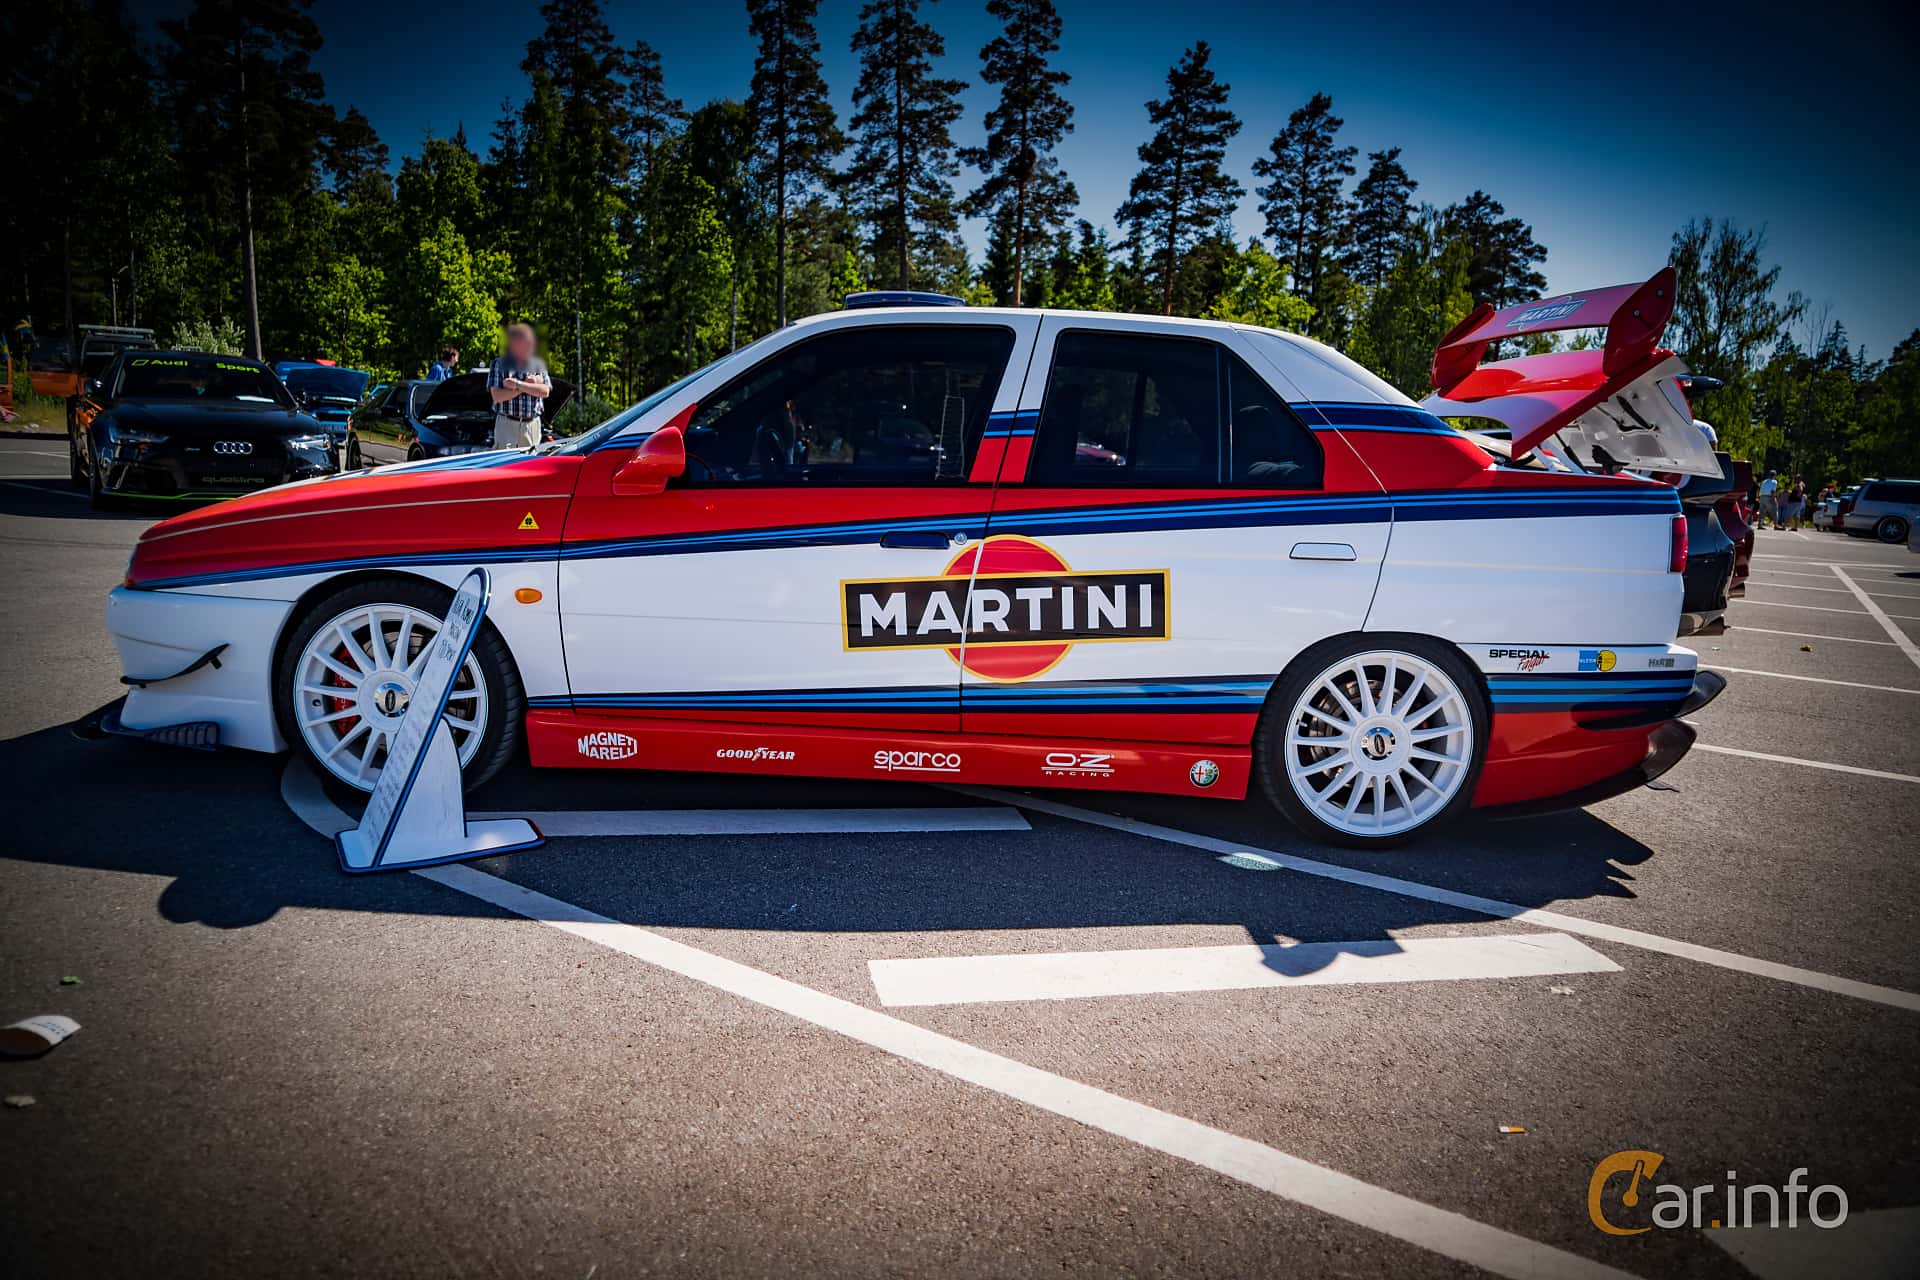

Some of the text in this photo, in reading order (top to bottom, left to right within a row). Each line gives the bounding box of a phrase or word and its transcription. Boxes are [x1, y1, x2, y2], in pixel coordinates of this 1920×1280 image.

[150, 359, 260, 373] Audi Sport
[202, 476, 265, 485] quattro
[859, 583, 1152, 637] MARTINI
[1489, 649, 1546, 659] SPECIAL
[577, 731, 638, 752] MAGNETI
[874, 750, 961, 771] sparco
[1045, 770, 1110, 778] RACING
